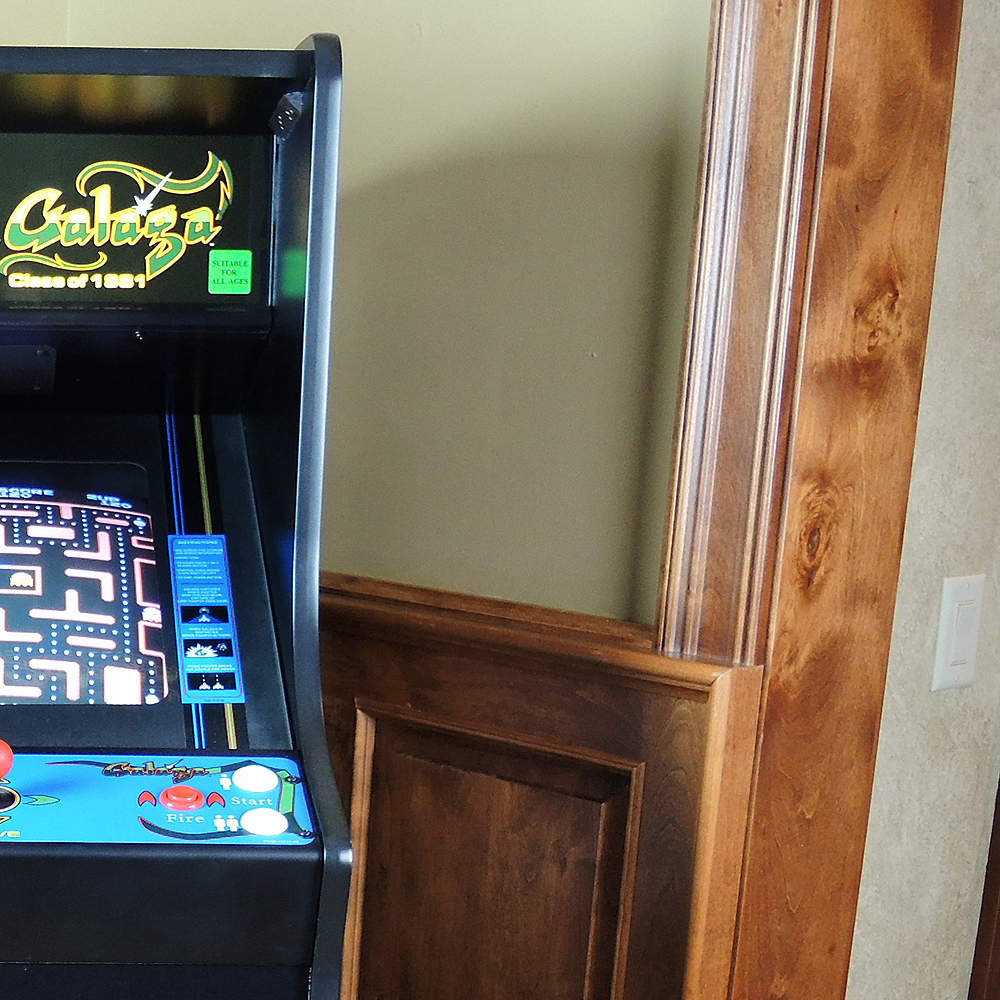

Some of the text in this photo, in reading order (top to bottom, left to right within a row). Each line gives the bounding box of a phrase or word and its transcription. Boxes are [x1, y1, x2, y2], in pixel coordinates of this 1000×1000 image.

[3, 183, 223, 281] Galaga
[211, 259, 249, 268] SUITABLE
[221, 268, 237, 276] FOR
[8, 272, 147, 289] Class of 1981
[211, 278, 249, 286] ALL AGES
[101, 761, 210, 785] Galaga
[231, 796, 273, 806] Start
[166, 813, 204, 824] Fire
